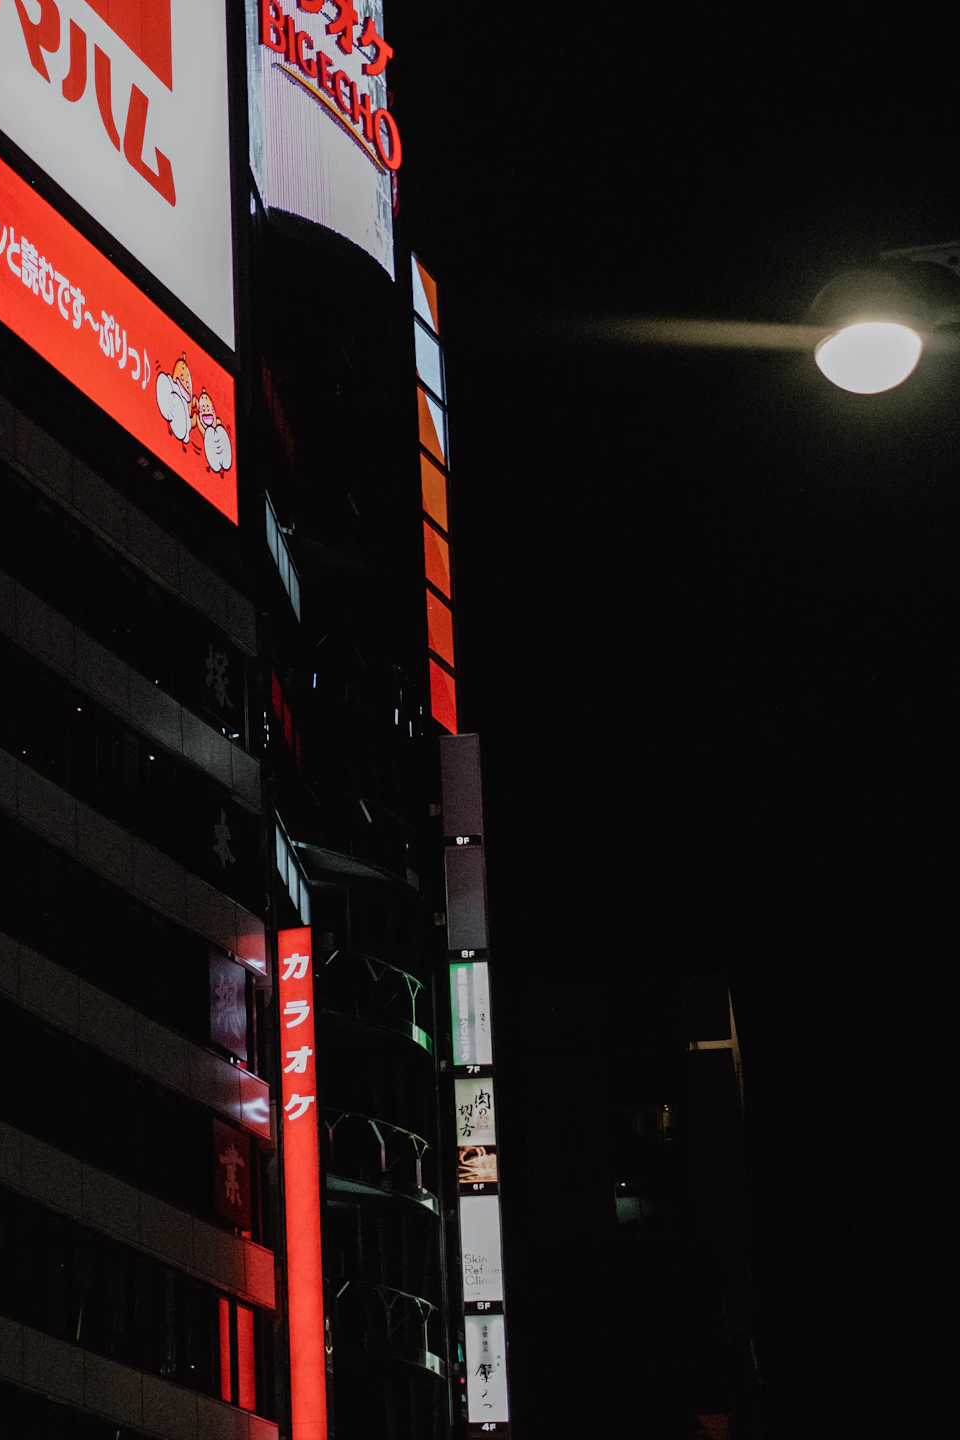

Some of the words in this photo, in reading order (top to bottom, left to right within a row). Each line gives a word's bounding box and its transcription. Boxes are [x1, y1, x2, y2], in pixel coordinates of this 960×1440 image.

[460, 949, 476, 959] 8F
[281, 952, 316, 1122] カラオケ
[466, 1064, 481, 1075] 7F
[472, 1182, 485, 1191] 6F
[464, 1253, 488, 1264] Skin
[464, 1263, 500, 1275] Refine
[476, 1301, 491, 1311] 5F
[481, 1422, 497, 1432] 4F
